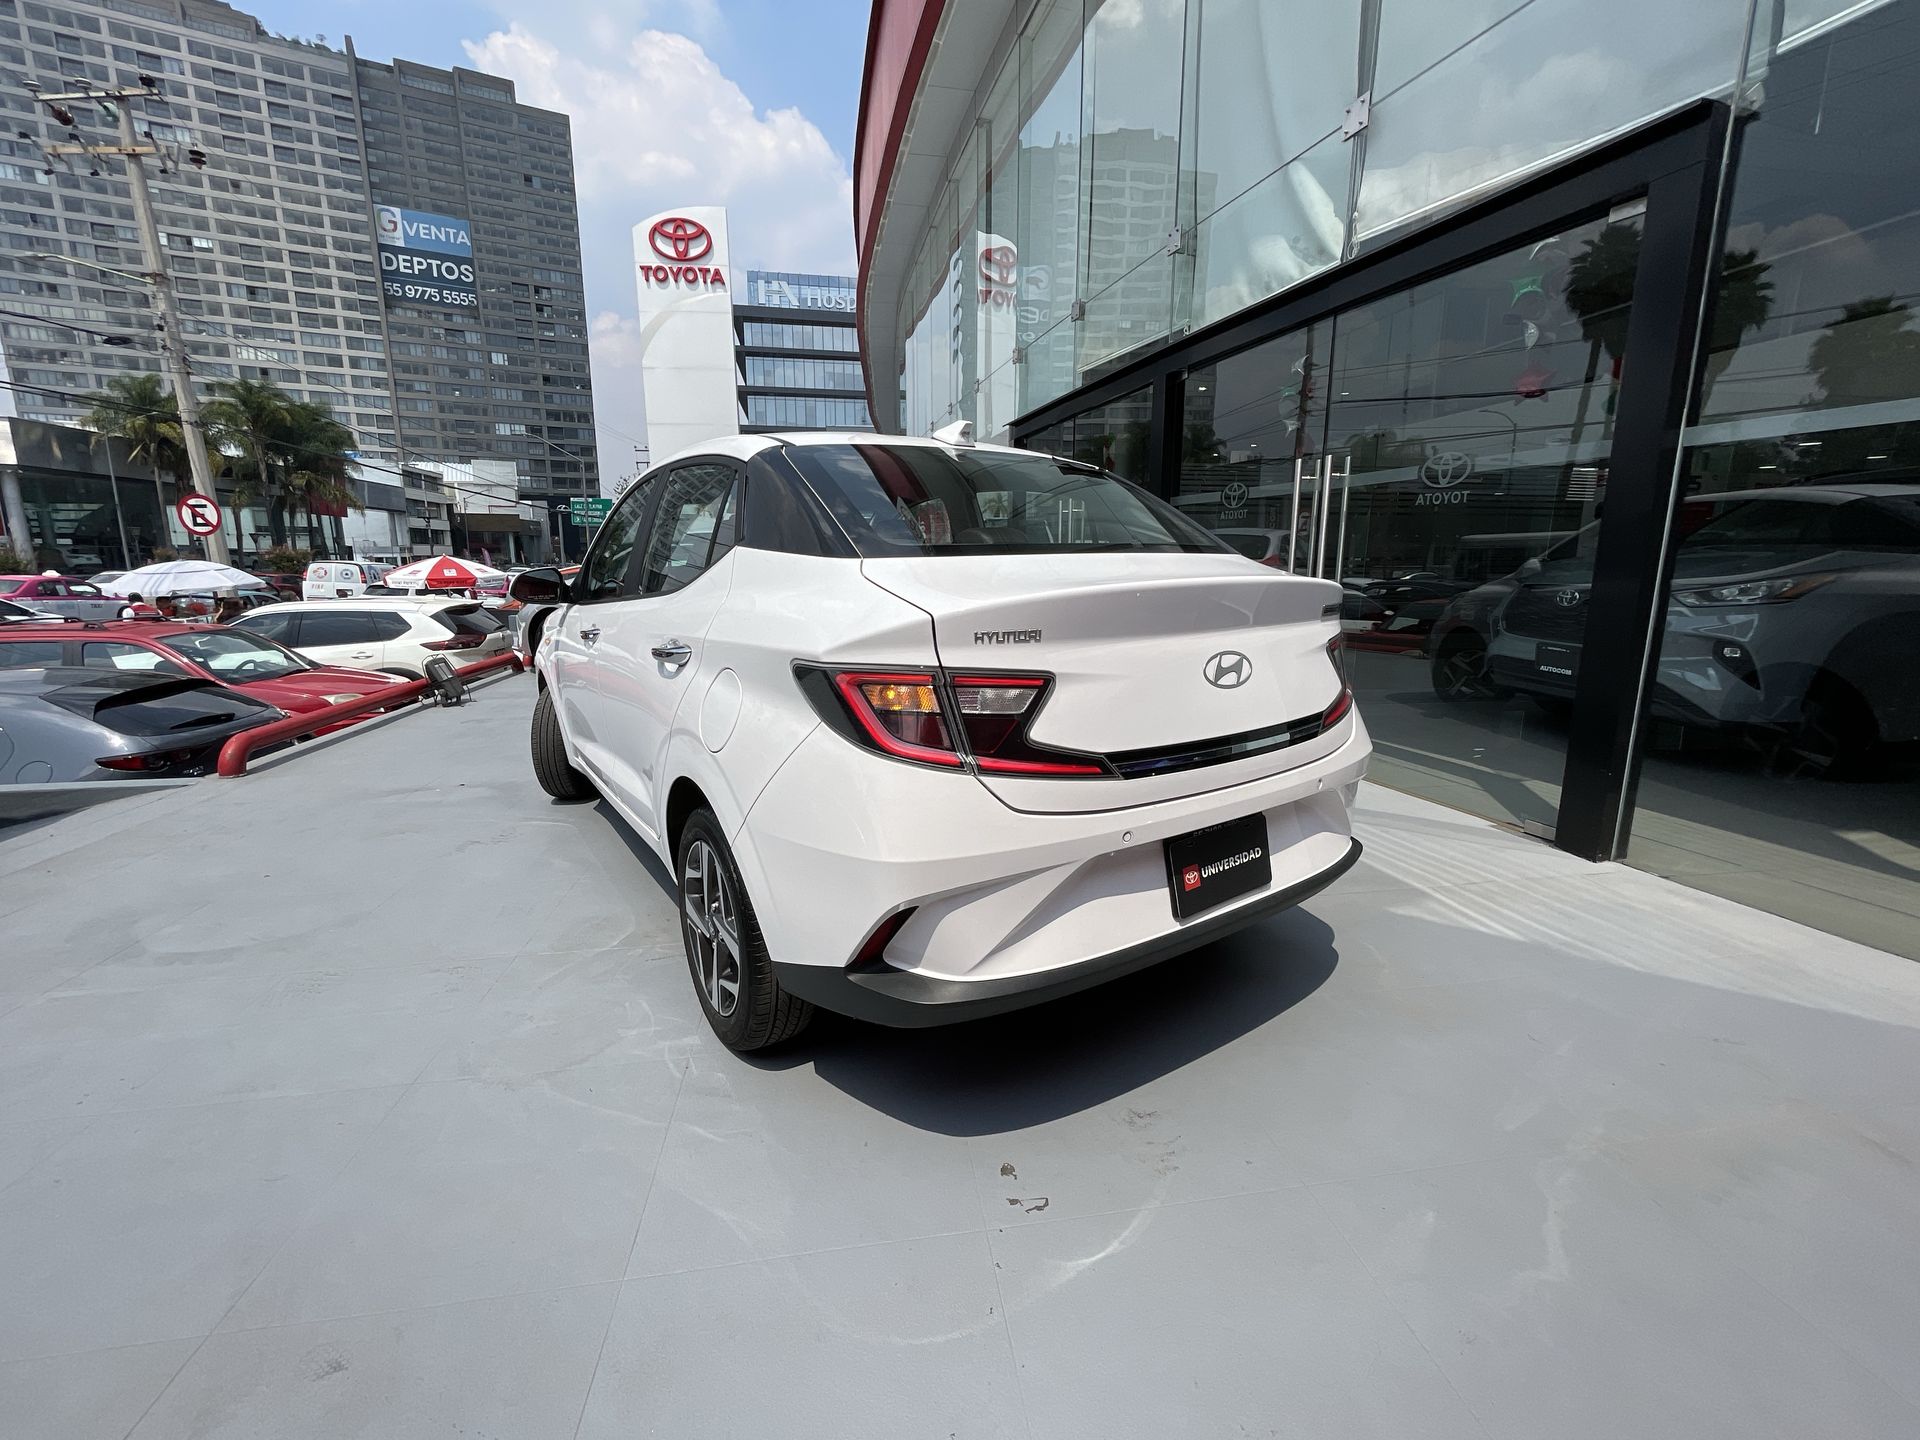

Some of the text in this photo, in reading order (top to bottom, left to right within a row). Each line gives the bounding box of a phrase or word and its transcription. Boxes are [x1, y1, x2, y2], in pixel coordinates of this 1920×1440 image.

[403, 220, 471, 246] VENTA
[380, 251, 474, 282] DEPTOS
[639, 265, 726, 287] TOYOTA
[384, 281, 478, 306] 55 9775 5555
[974, 629, 1042, 645] HYUNDAI
[1201, 847, 1262, 879] UNIVERSIDAD
